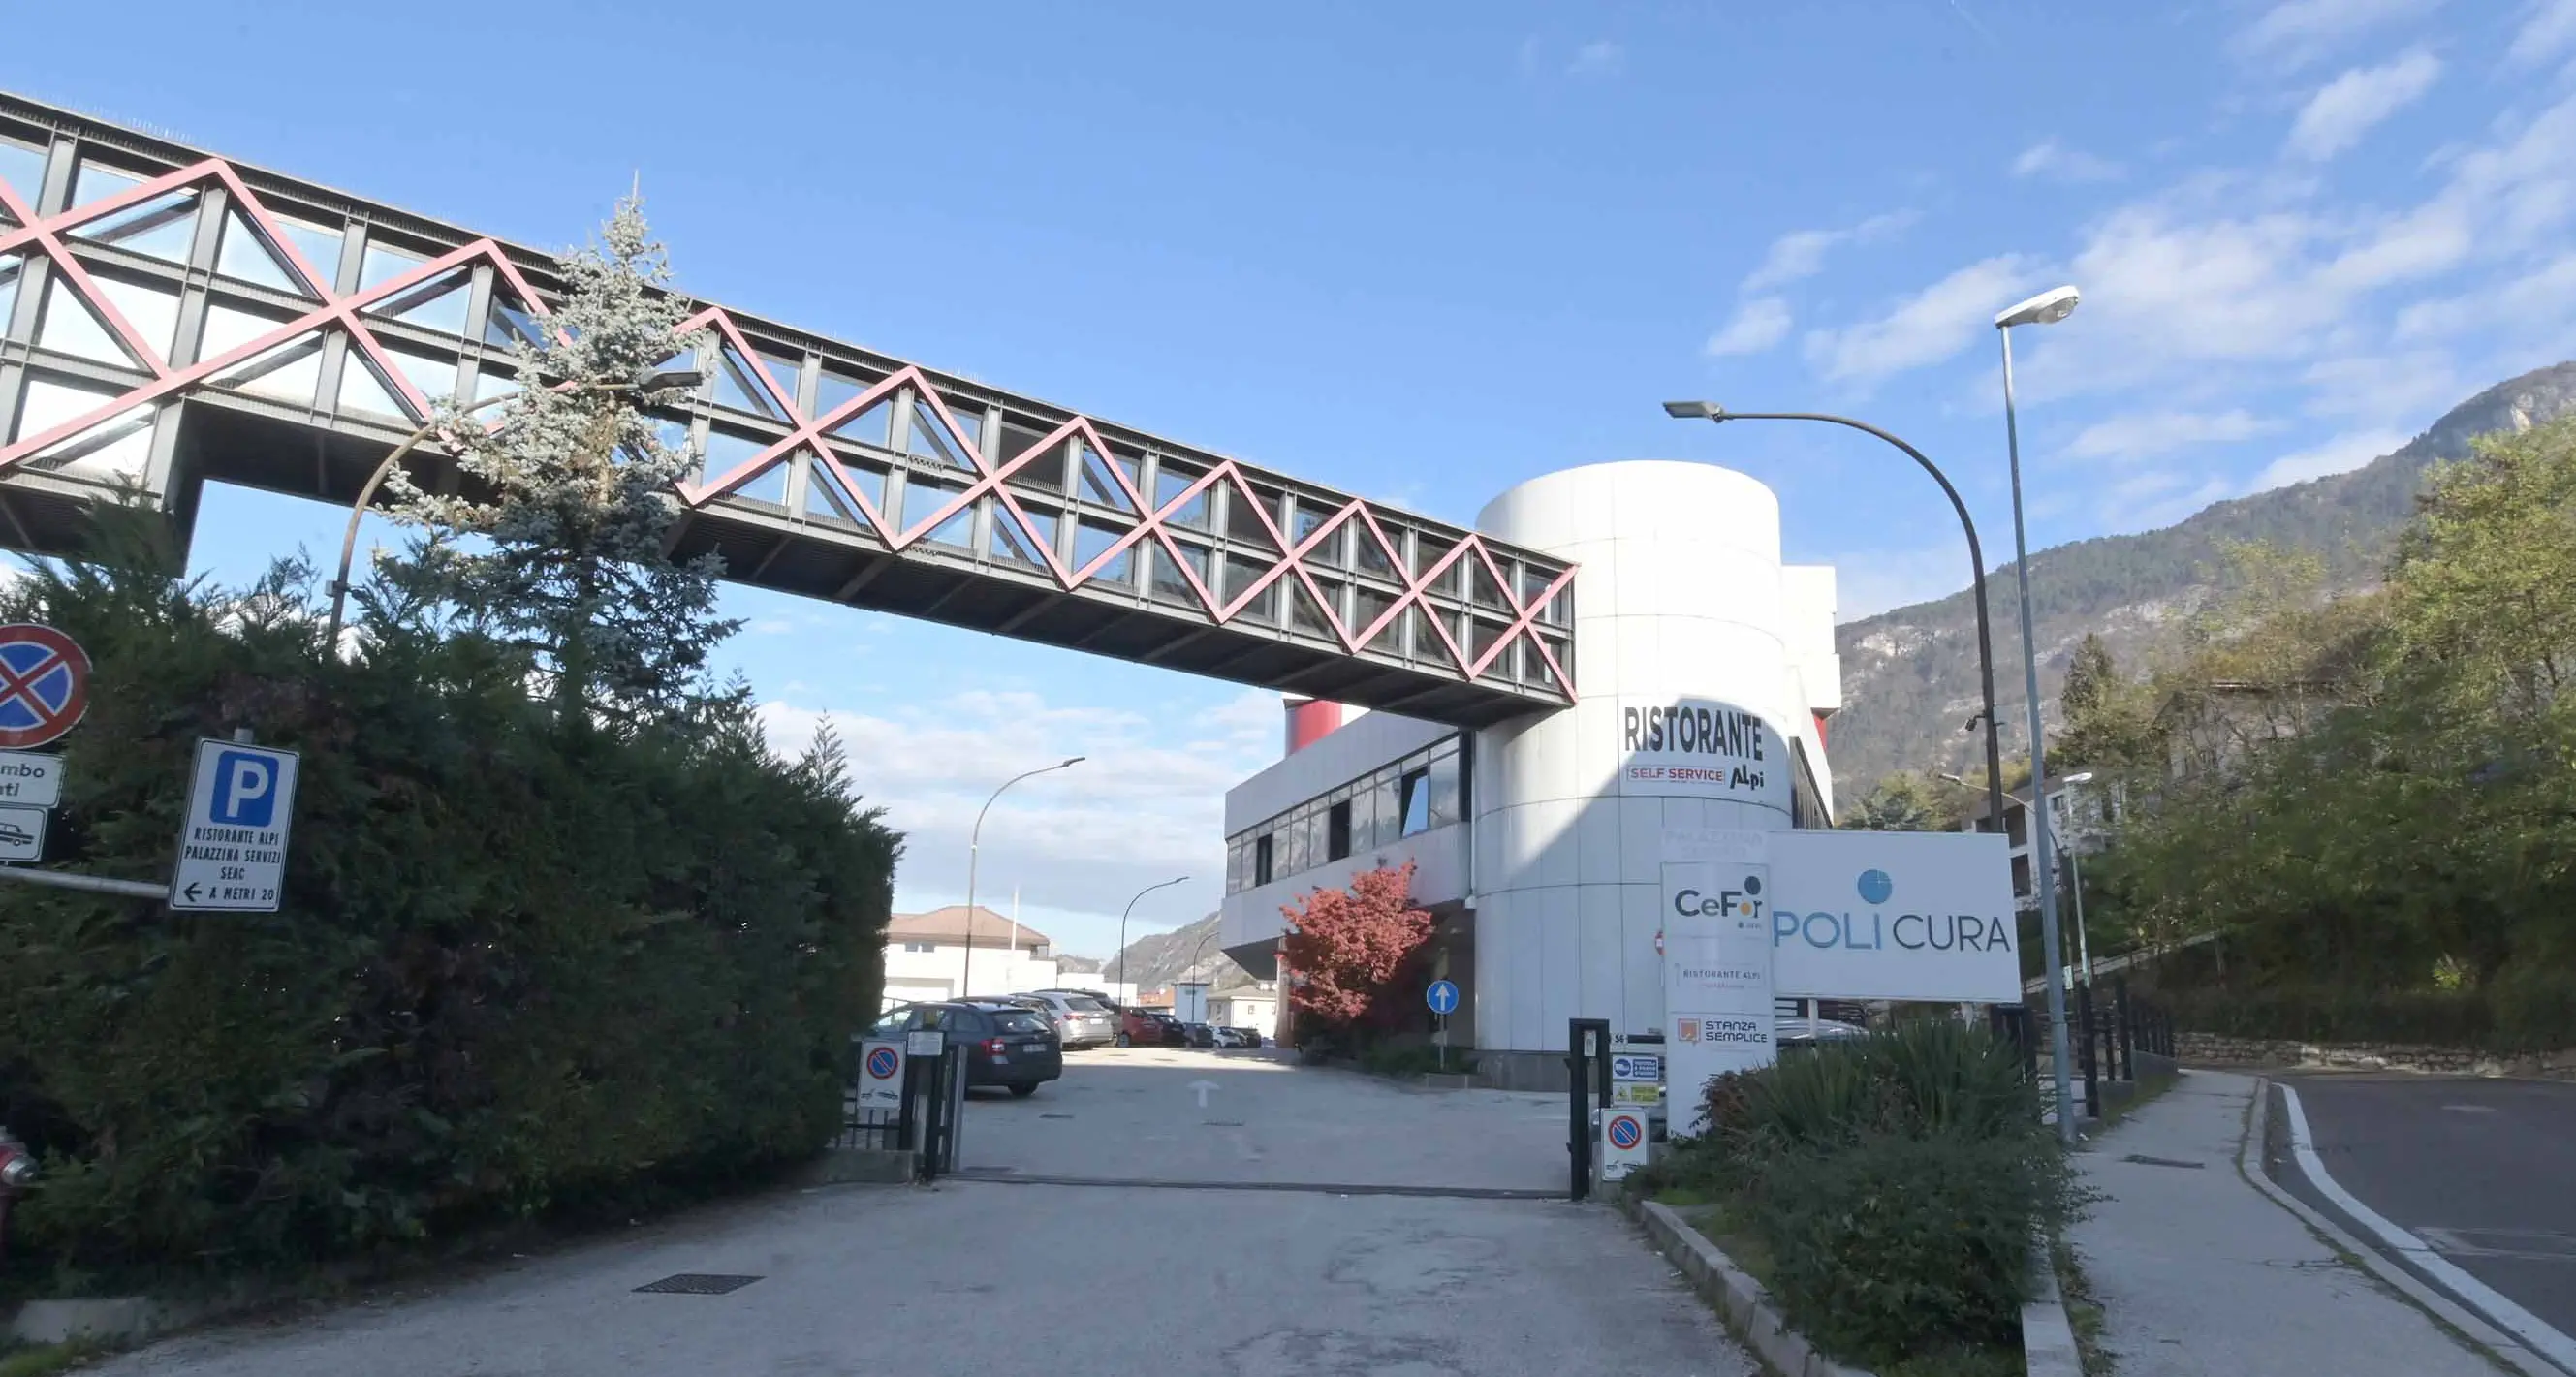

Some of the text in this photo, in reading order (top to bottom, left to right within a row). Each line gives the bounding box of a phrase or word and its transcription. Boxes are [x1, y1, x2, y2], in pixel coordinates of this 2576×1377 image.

[1624, 705, 1764, 761] RISTORANTE
[0, 763, 45, 778] mbo
[1630, 767, 1723, 782] SELF SERVICE
[226, 759, 269, 818] P
[194, 827, 280, 846] RISTORANTE ALPI
[183, 845, 281, 863] PALAZZINA SERVIZI
[208, 887, 275, 901] A METRI 20
[1683, 969, 1741, 980] RISTORANTE
[1705, 1021, 1757, 1032] STANZA
[1705, 1032, 1768, 1043] SEMPLICE
